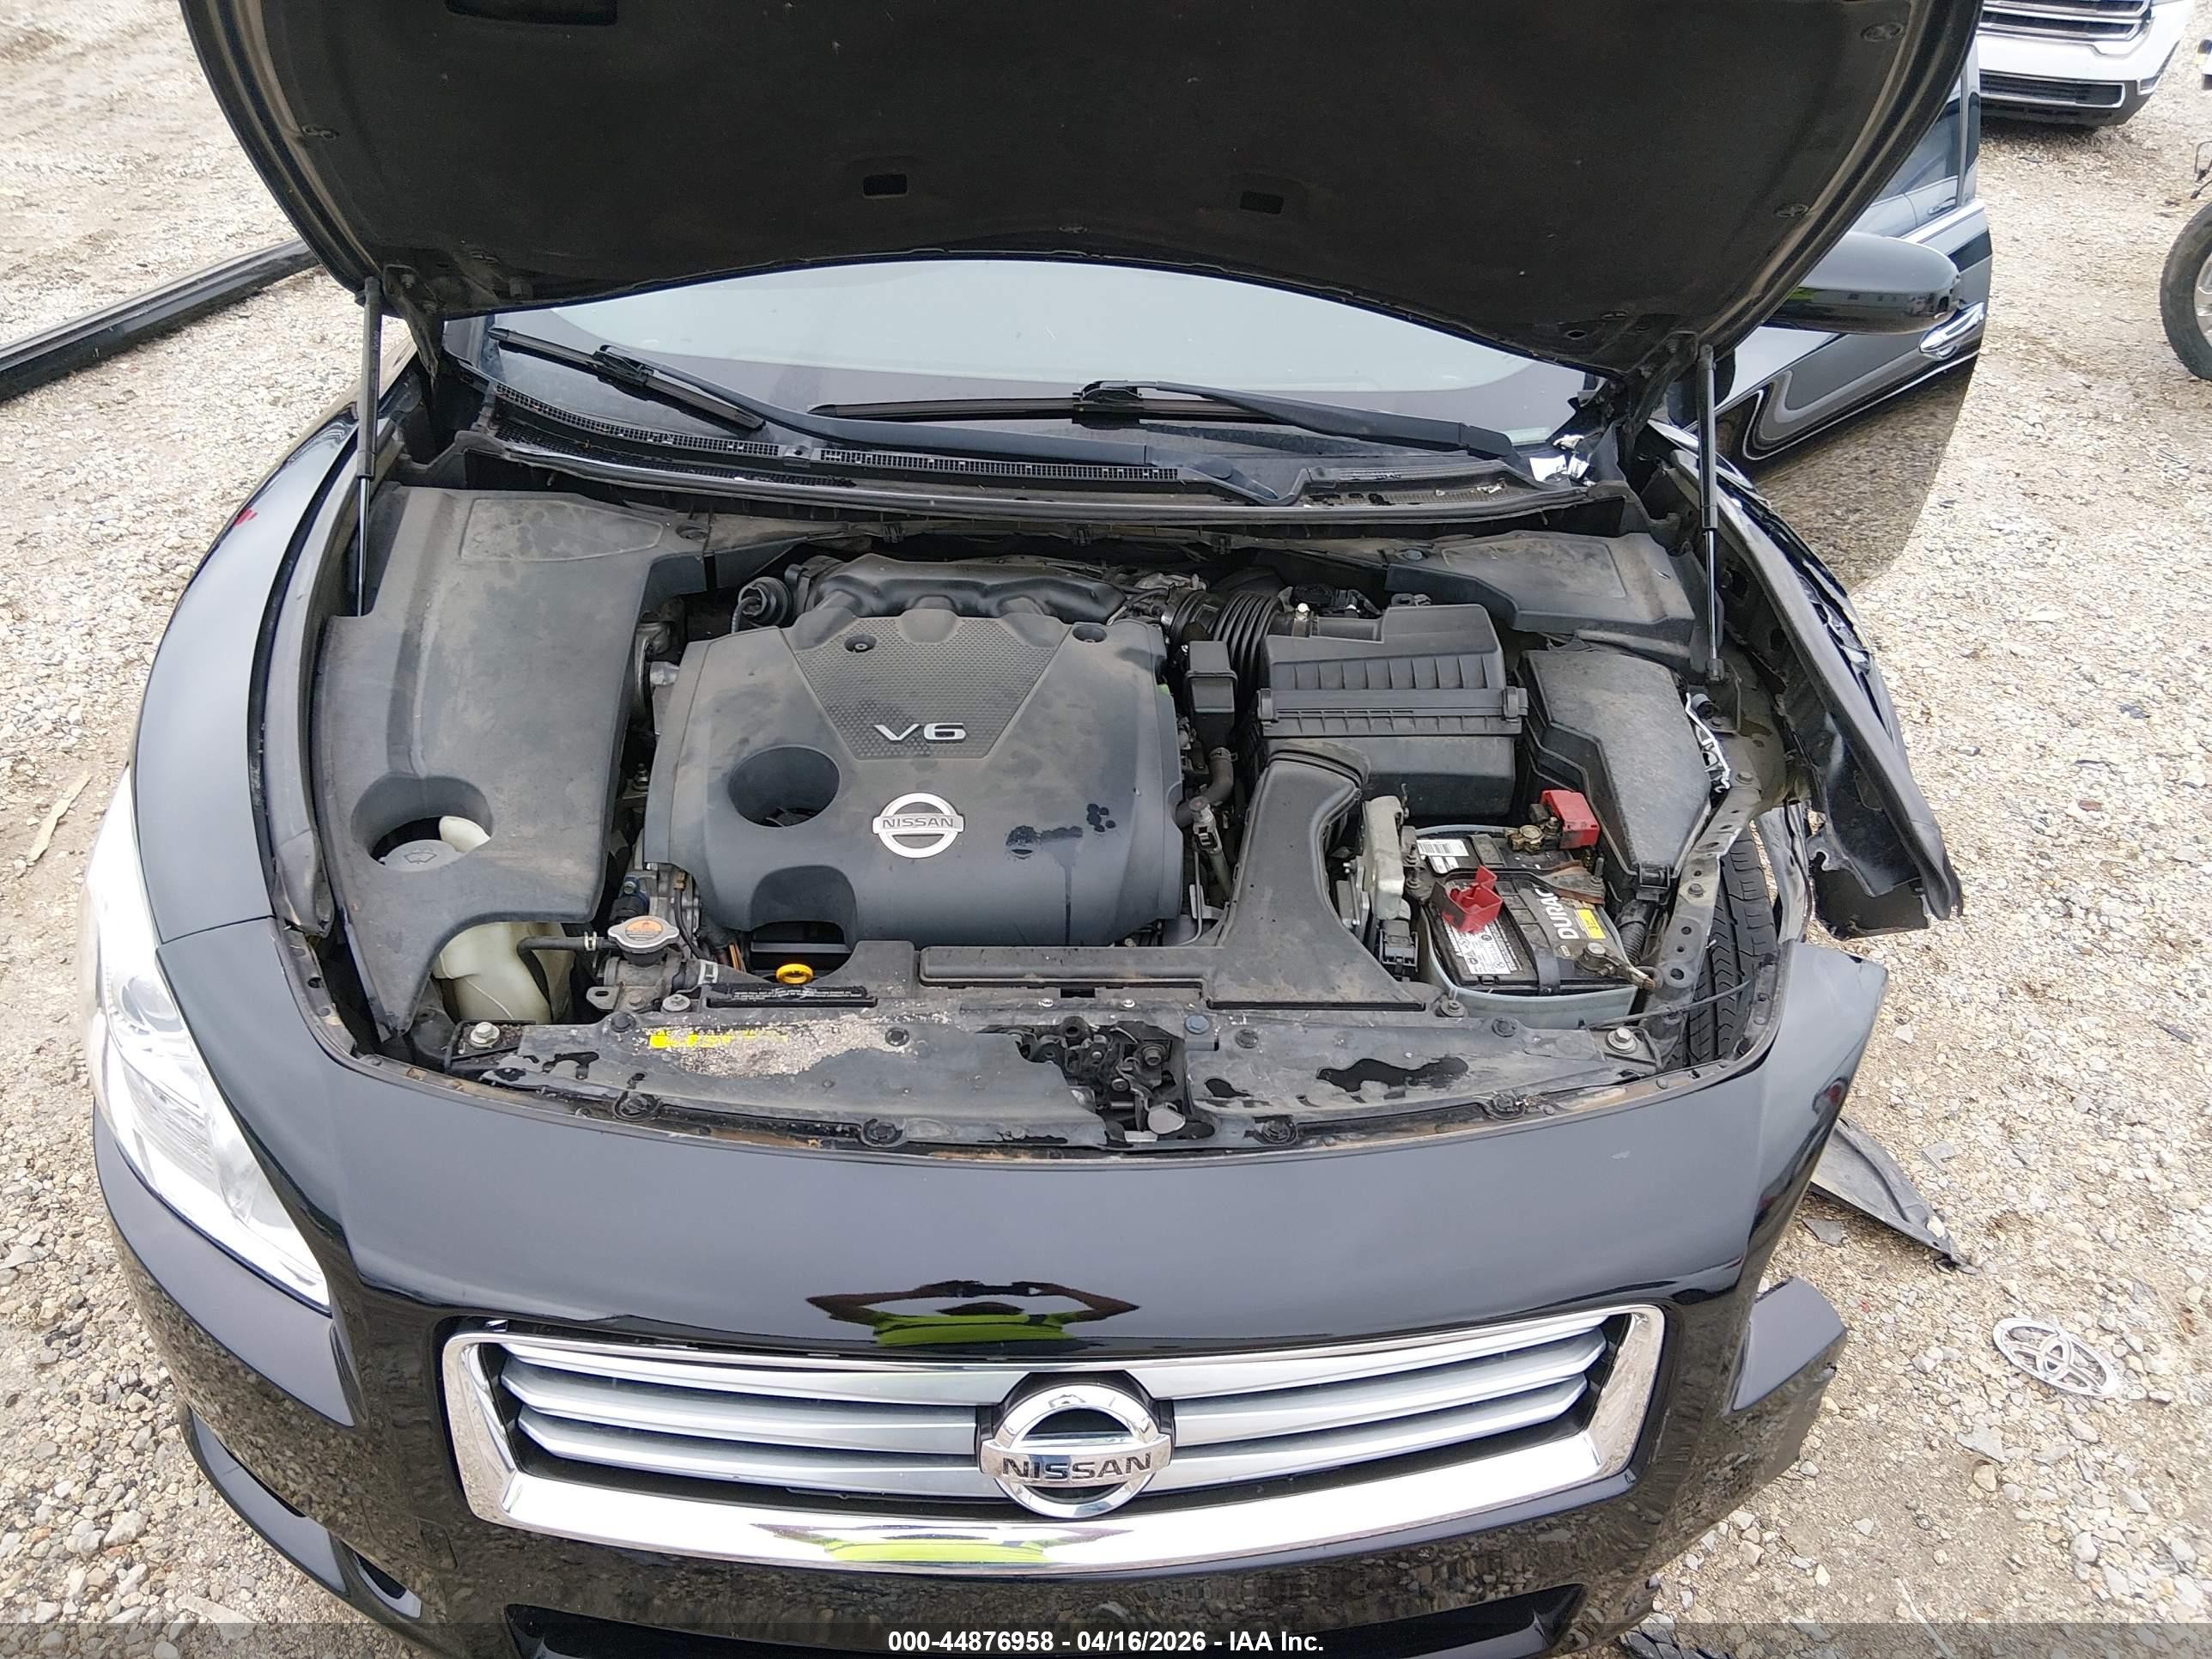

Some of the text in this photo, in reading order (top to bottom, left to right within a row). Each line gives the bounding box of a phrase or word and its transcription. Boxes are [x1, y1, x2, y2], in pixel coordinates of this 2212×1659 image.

[873, 722, 967, 743] V6
[882, 817, 954, 829] NISSAN
[1533, 884, 1580, 939] DURAC
[1002, 1452, 1152, 1480] NISSAN
